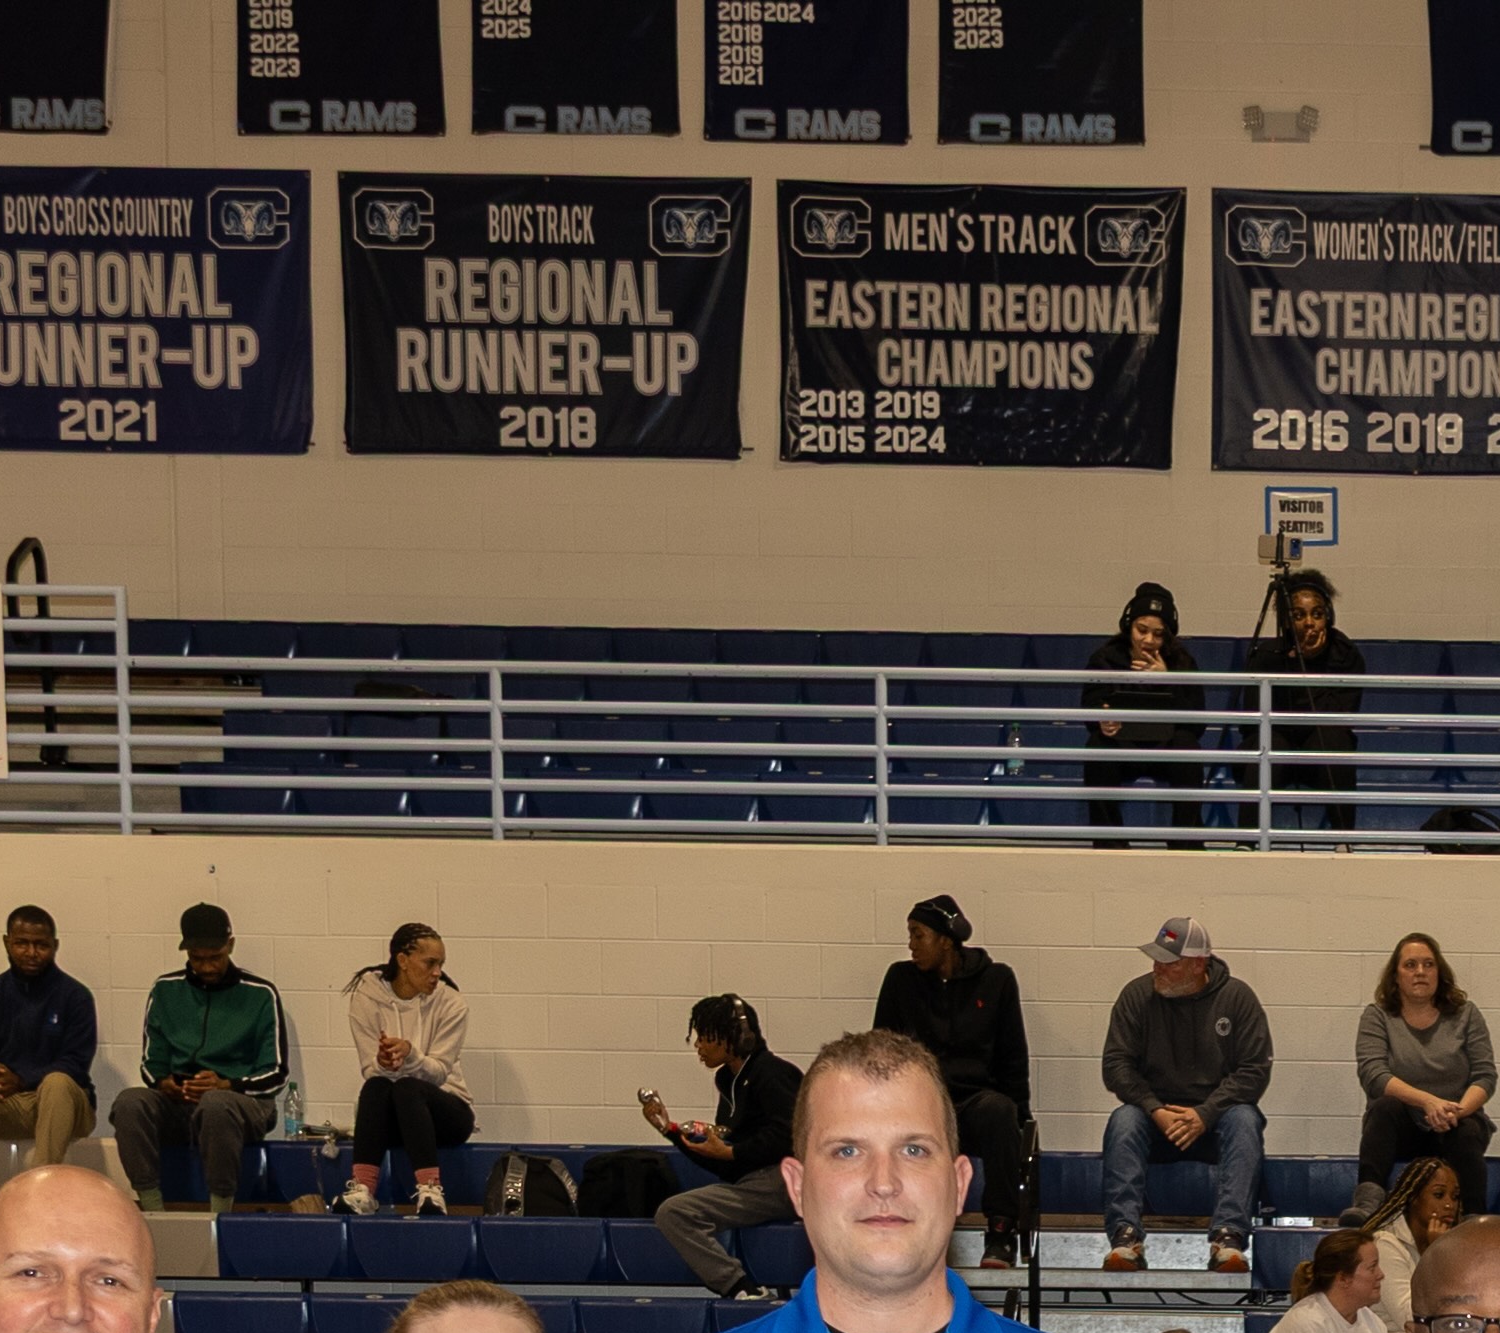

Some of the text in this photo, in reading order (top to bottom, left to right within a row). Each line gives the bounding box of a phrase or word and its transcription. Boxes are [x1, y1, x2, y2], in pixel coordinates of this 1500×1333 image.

[250, 33, 299, 53] 2022
[719, 45, 762, 65] 2019
[250, 58, 301, 78] 2023
[719, 66, 763, 86] 2021
[788, 109, 881, 141] RAMS
[488, 203, 595, 245] BOYS TRACK
[884, 205, 1076, 256] MEN'S TRACK
[1313, 222, 1395, 262] WOMEN'S
[425, 258, 673, 327] REGIONAL
[805, 279, 1159, 336] EASTERN REGIONAL
[1249, 288, 1420, 341] EASTERN
[396, 327, 698, 396] RUNNER-UP
[876, 340, 1095, 391] CHAMPIONS
[59, 400, 157, 443] 2021
[799, 390, 940, 420] 2013 2019
[500, 405, 597, 448] 2018
[799, 424, 947, 453] 2015 2024
[1252, 409, 1348, 451] 2016
[1367, 412, 1463, 454] 2018
[1279, 500, 1324, 513] VISITOR
[1279, 520, 1324, 533] SEATING
